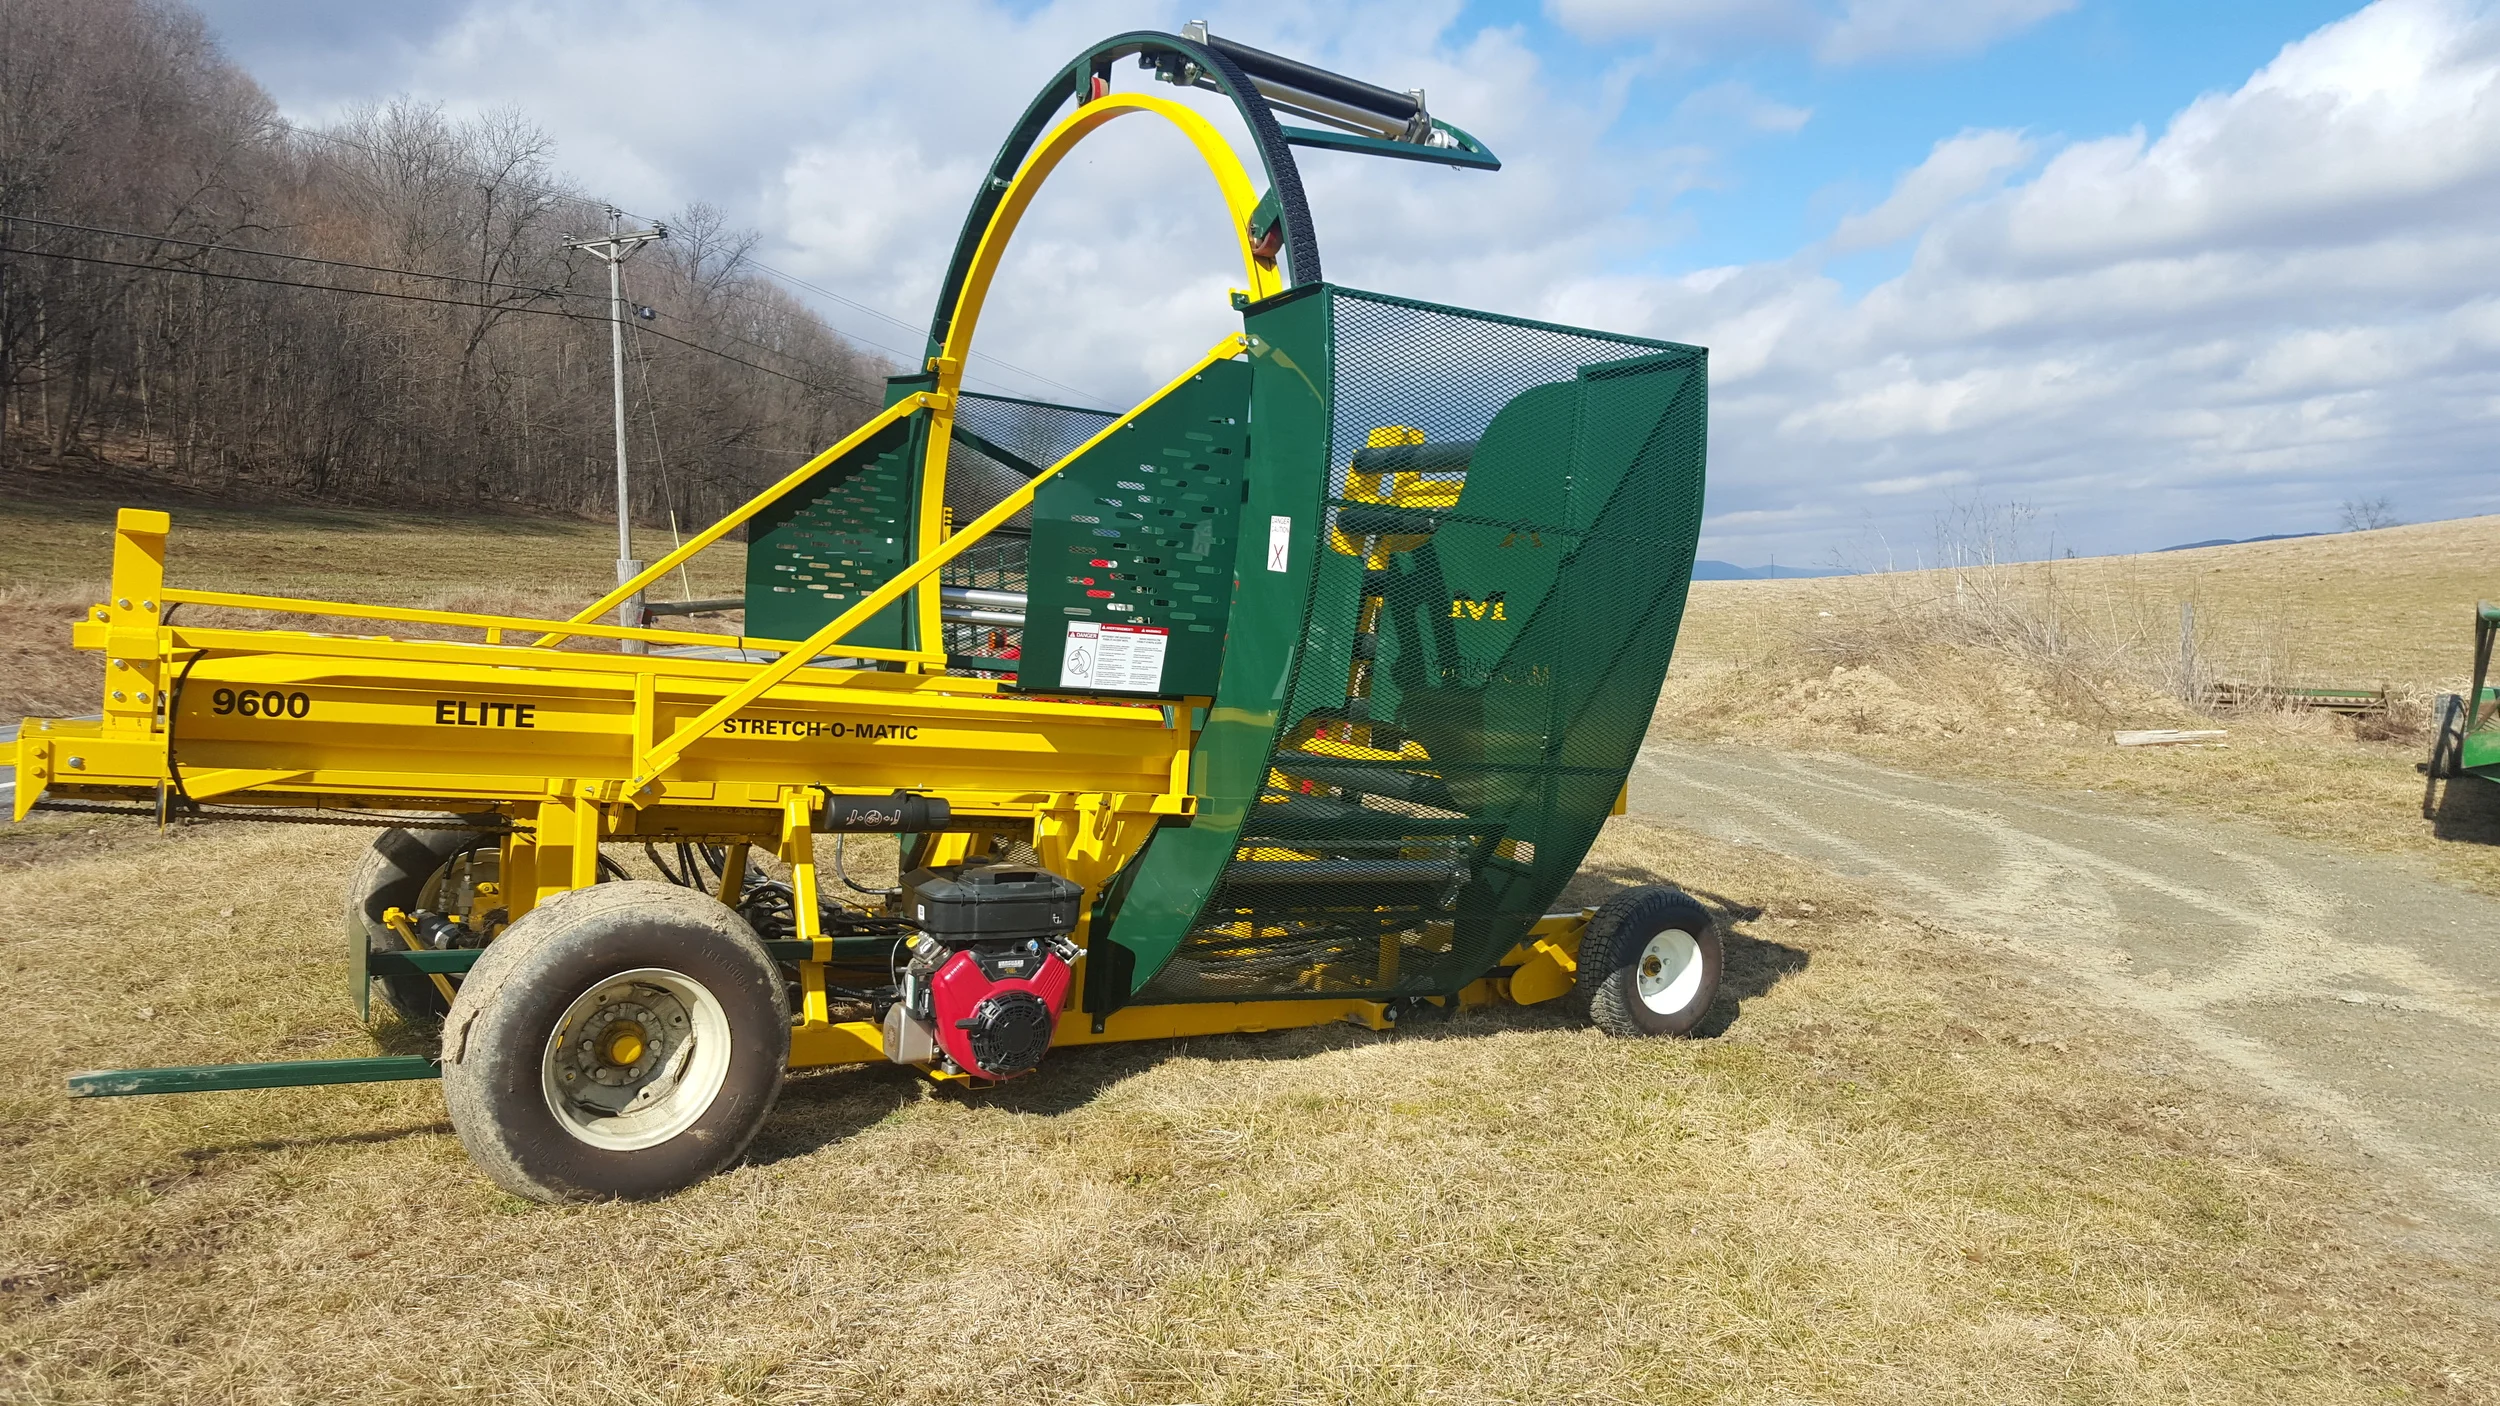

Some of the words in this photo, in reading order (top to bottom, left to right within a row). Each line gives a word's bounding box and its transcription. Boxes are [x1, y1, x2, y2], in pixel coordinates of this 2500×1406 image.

[212, 688, 310, 718] 9600
[436, 700, 536, 728] ELITE
[723, 718, 918, 740] STRETCH-O-MATIC
